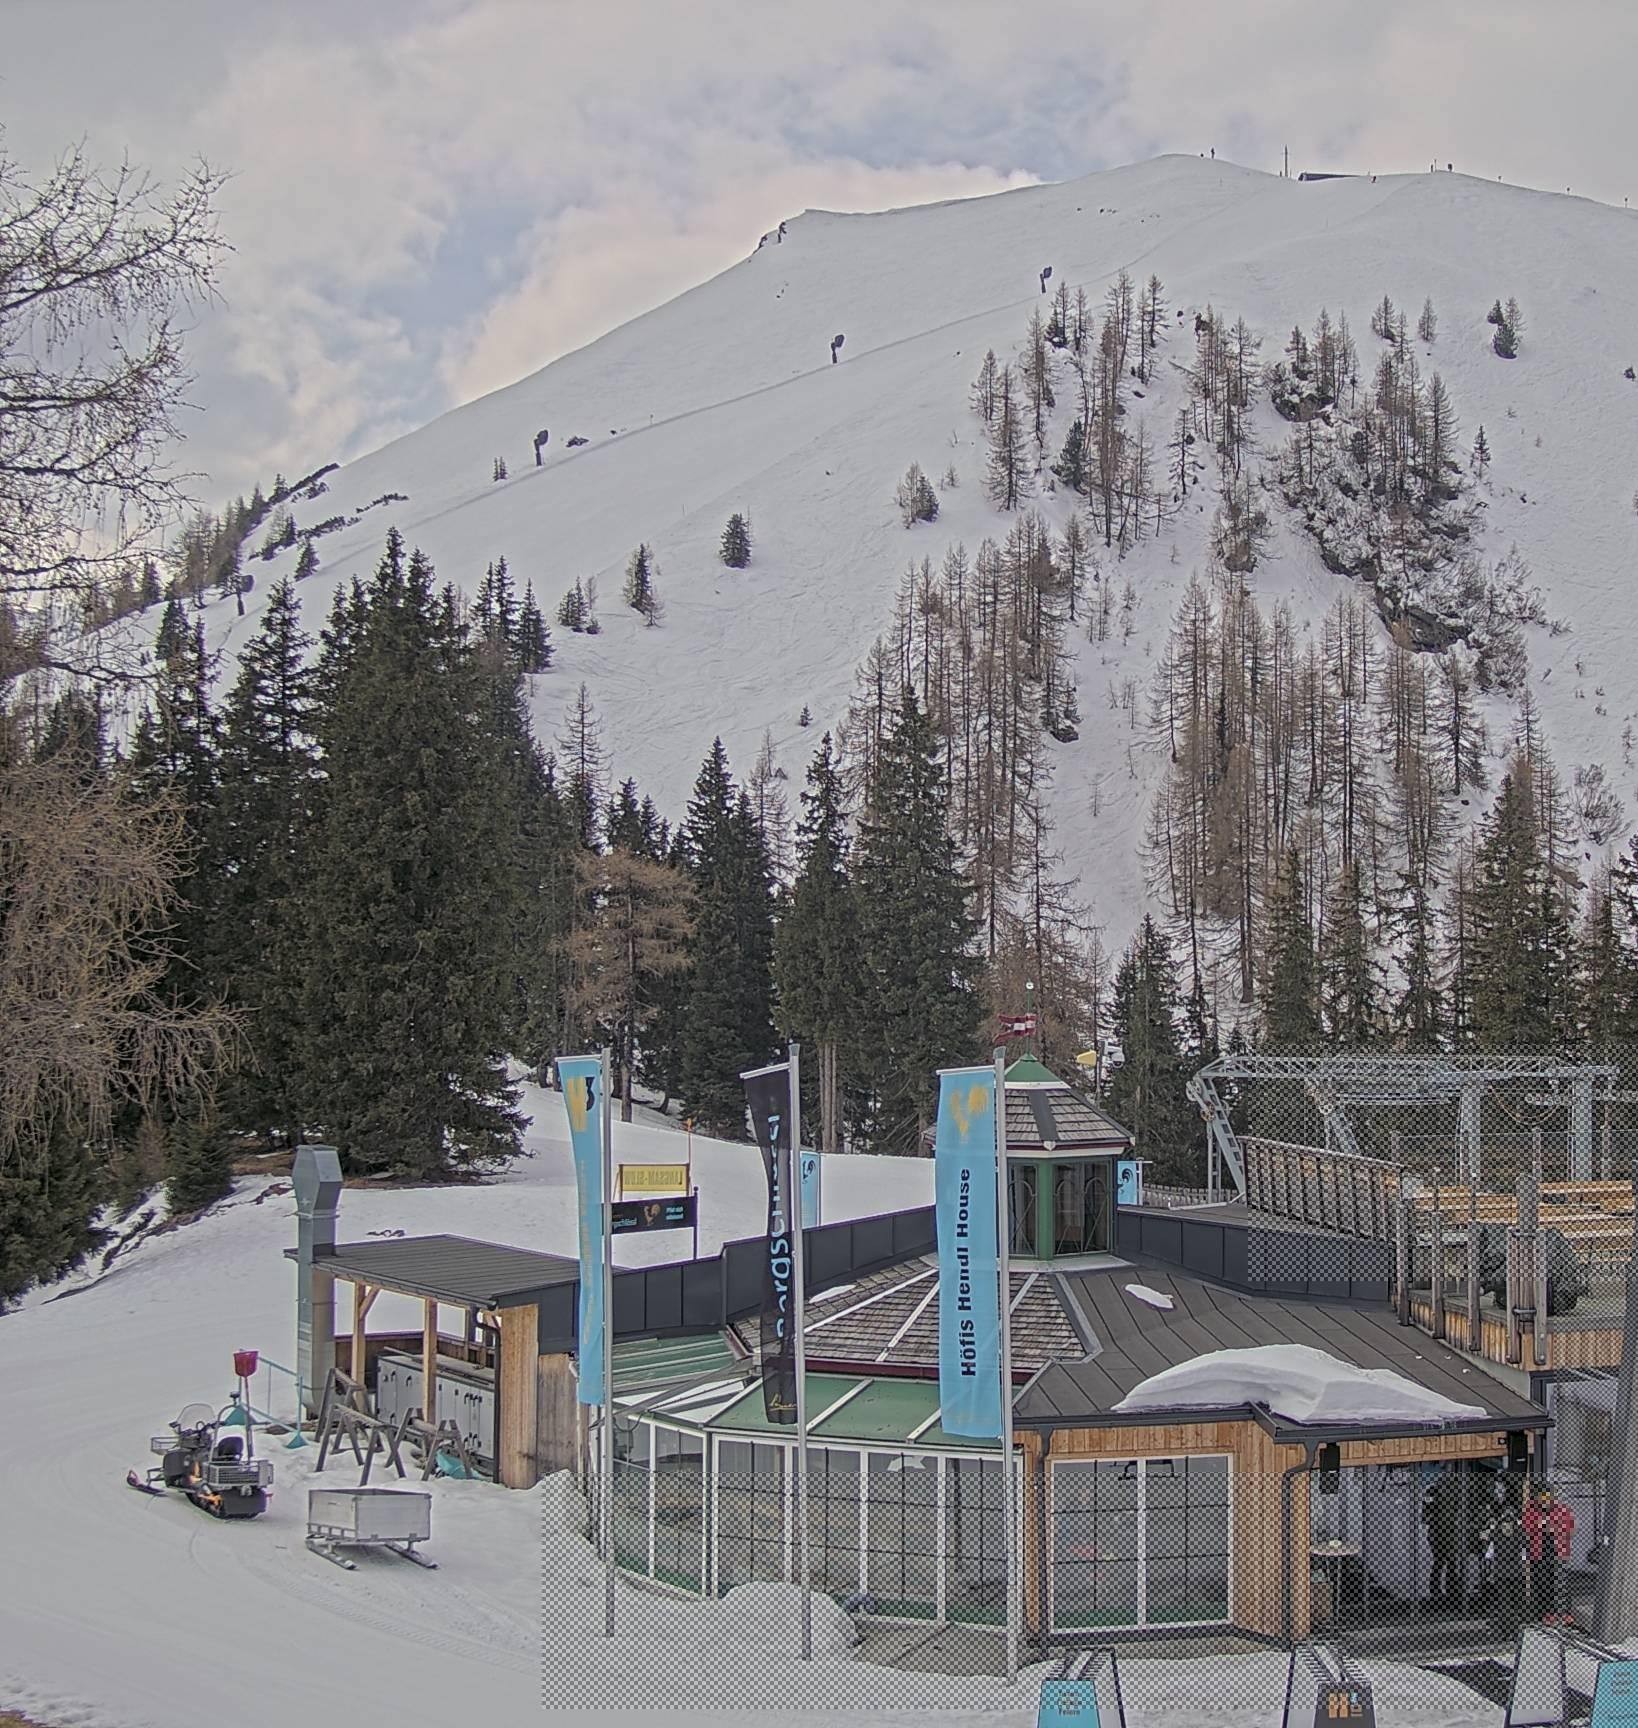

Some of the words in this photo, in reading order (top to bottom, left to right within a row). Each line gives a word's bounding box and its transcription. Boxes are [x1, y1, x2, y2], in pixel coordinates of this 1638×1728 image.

[956, 1168, 970, 1237] House
[957, 1247, 971, 1311] Hendl
[959, 1319, 976, 1377] Höfis
